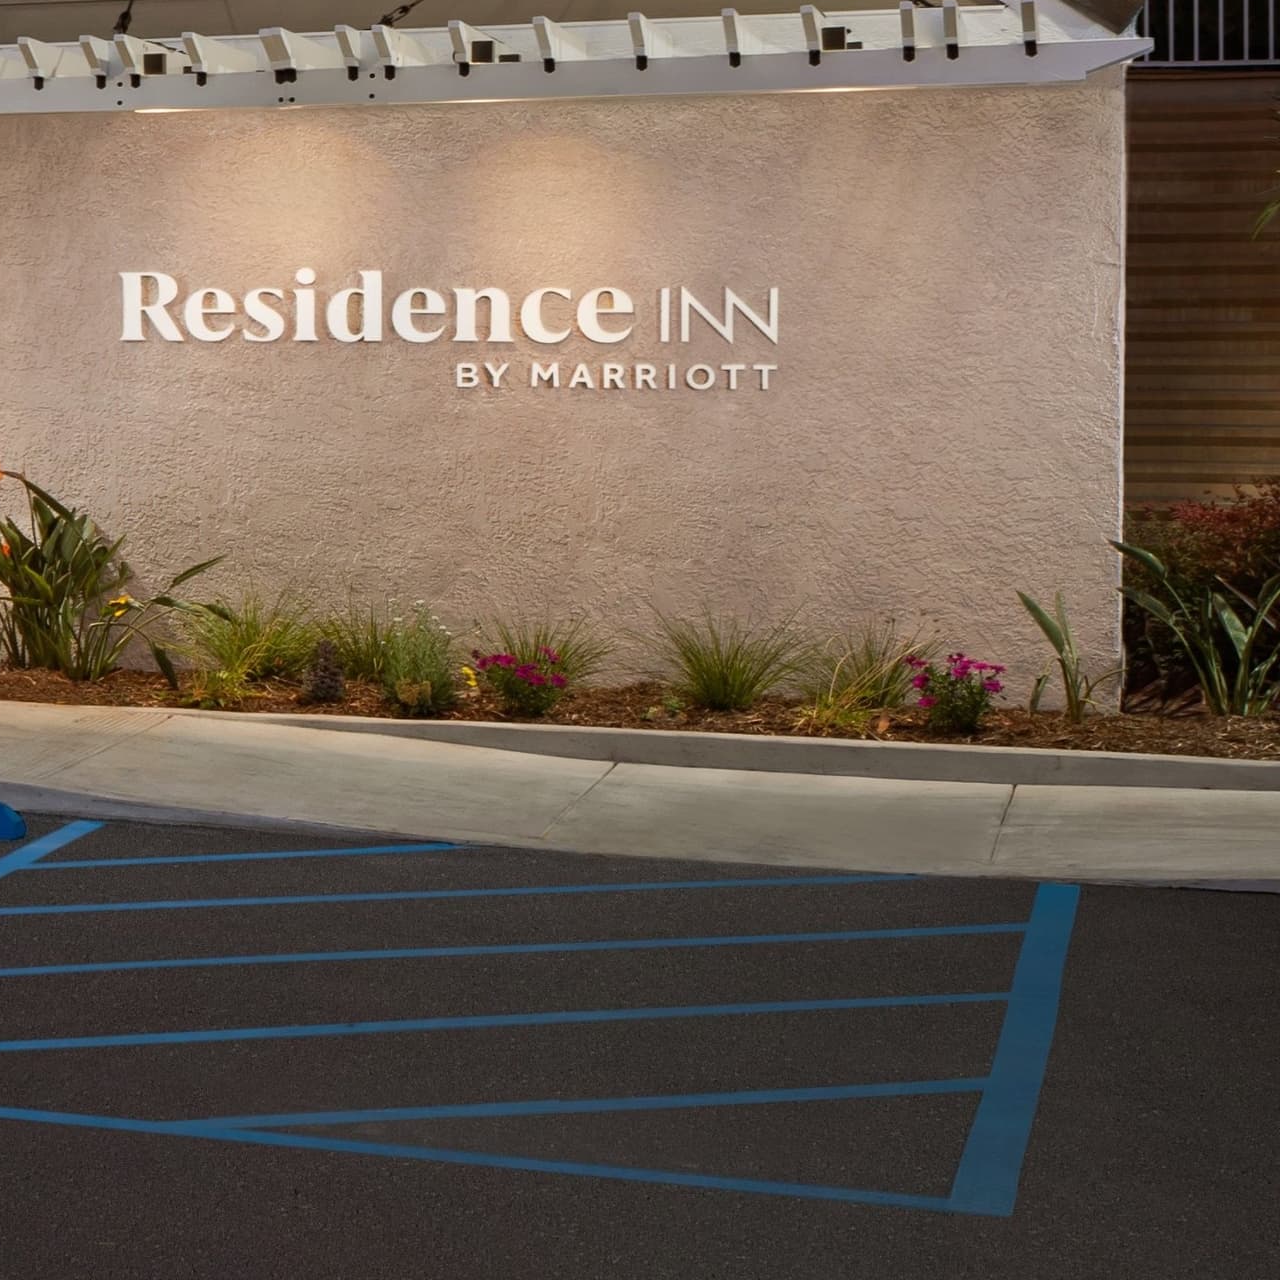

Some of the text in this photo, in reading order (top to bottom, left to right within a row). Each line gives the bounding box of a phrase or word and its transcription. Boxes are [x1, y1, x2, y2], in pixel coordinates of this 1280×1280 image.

[119, 267, 779, 344] Residence INN
[456, 363, 778, 390] BY MARRIOTT
